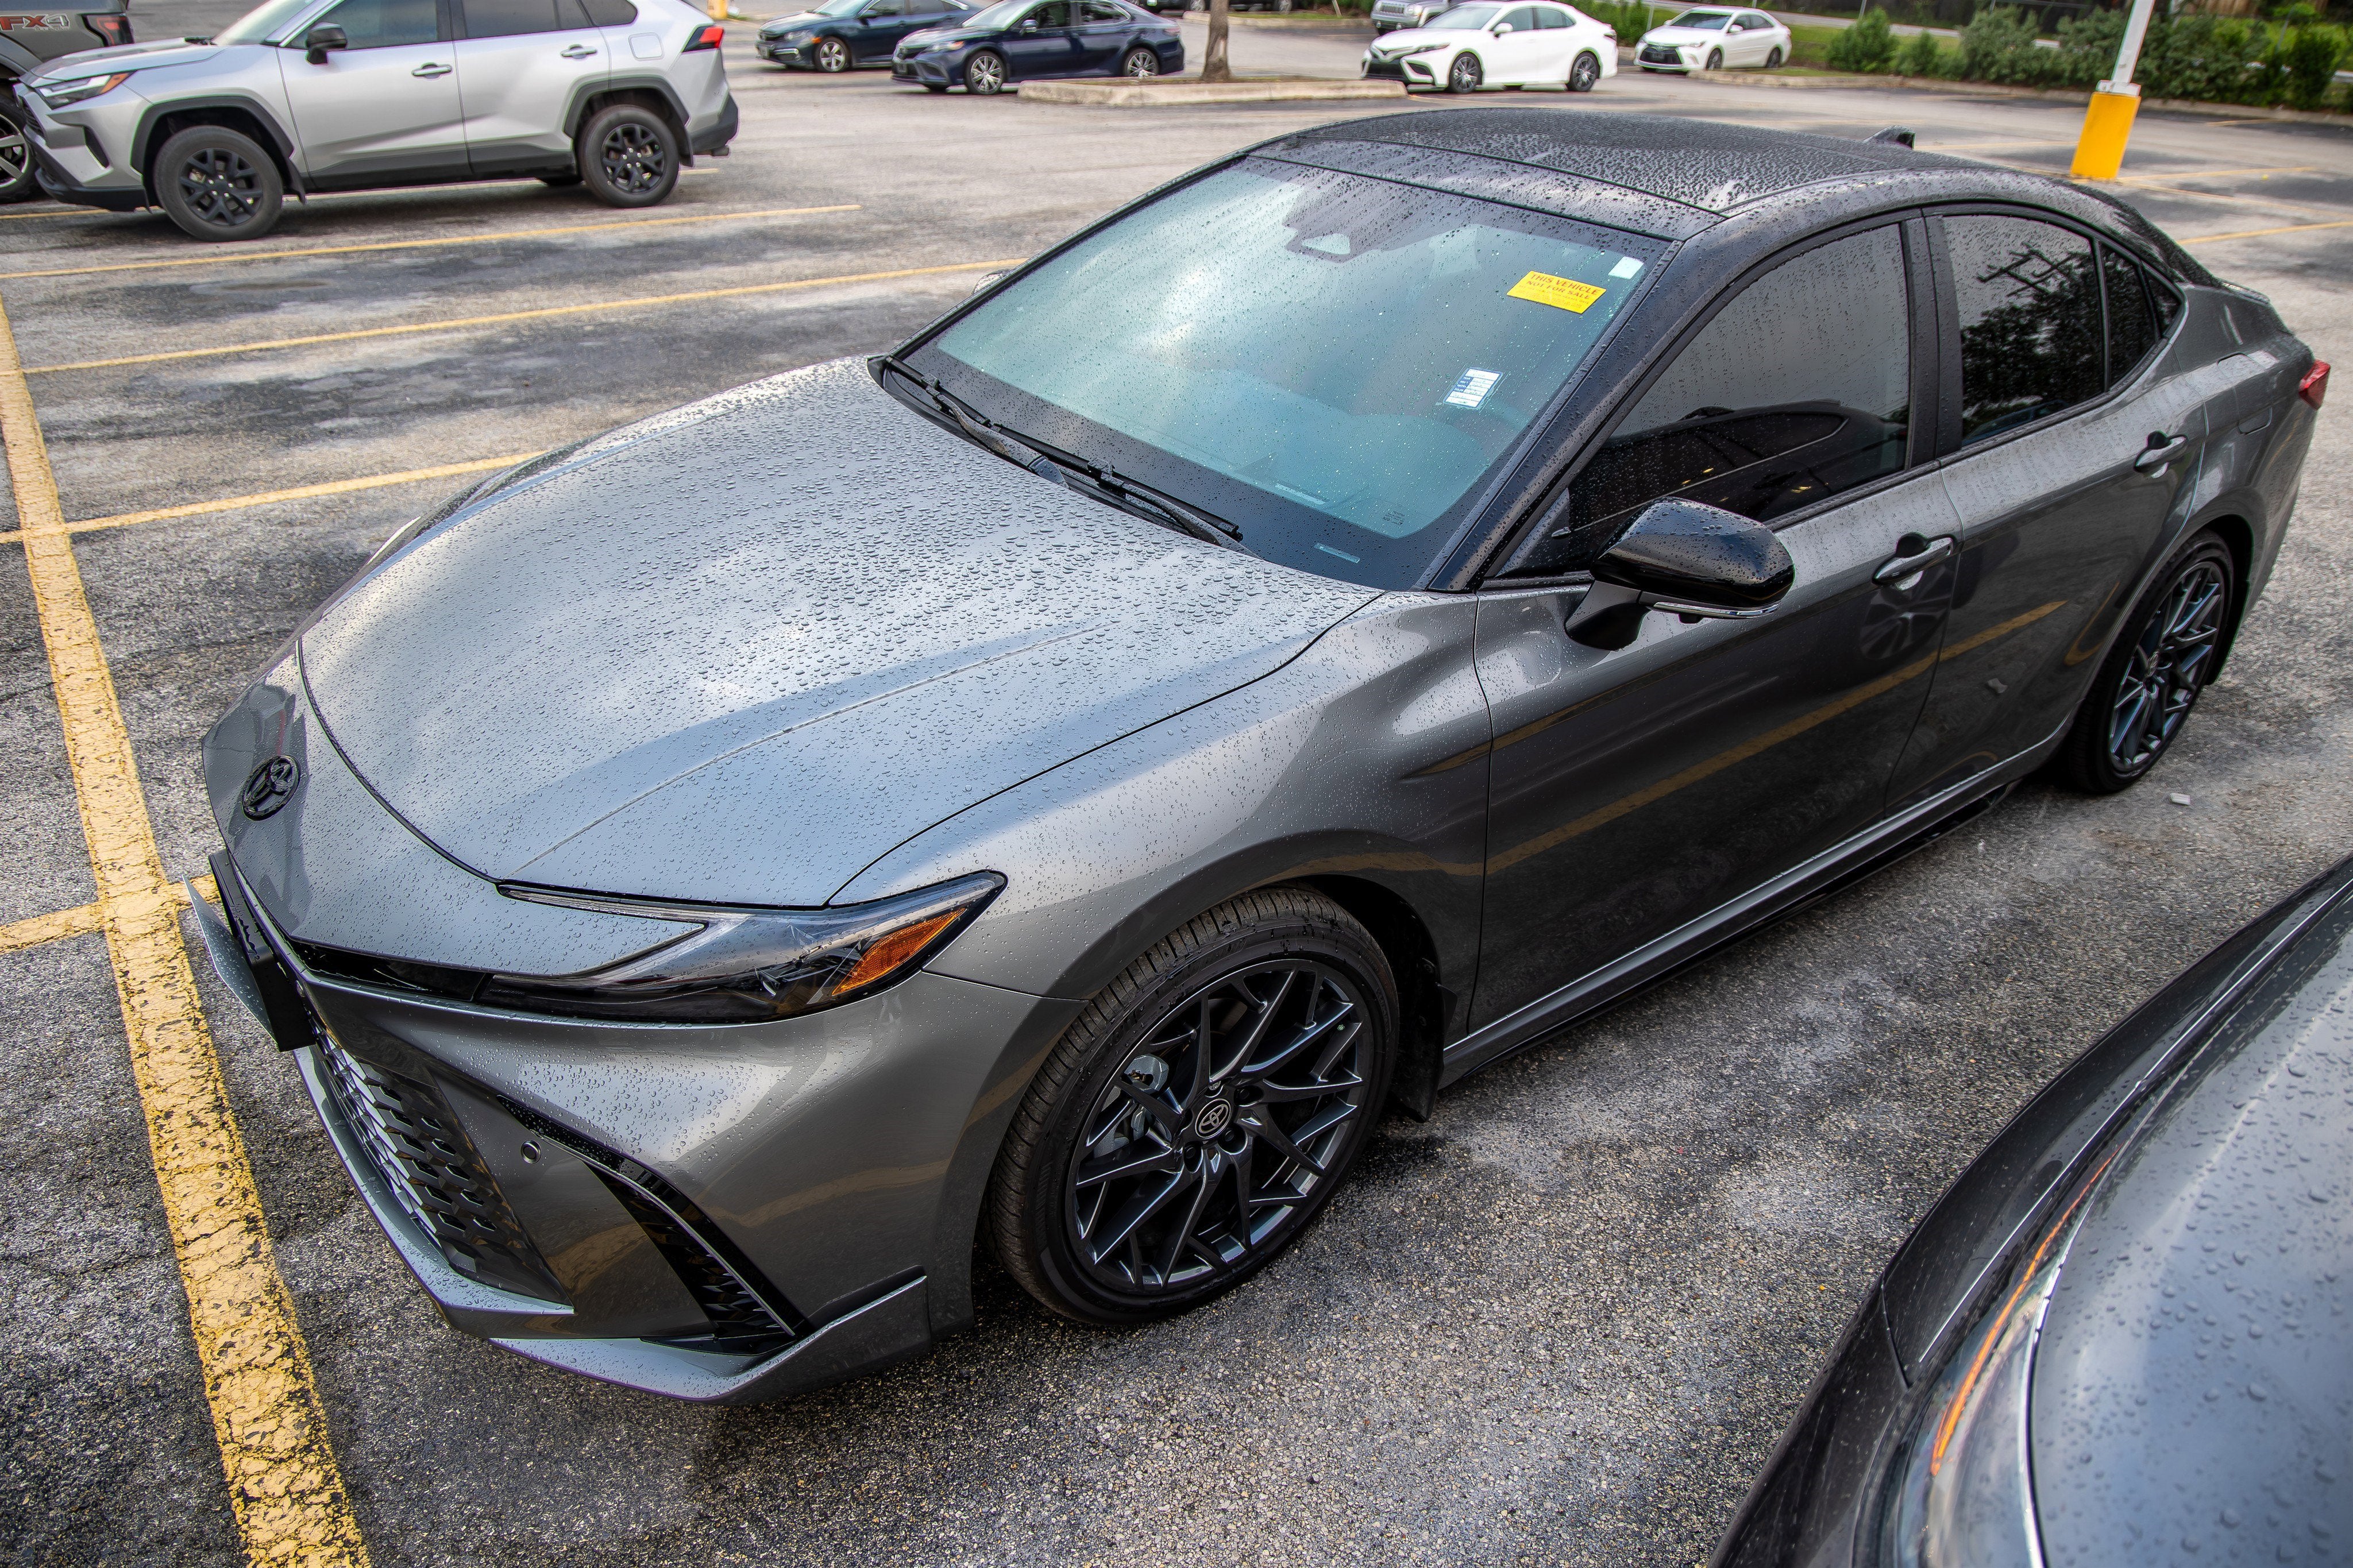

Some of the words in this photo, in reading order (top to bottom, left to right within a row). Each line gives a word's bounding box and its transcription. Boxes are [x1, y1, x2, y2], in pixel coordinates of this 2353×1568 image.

[0, 14, 70, 32] FX4
[1530, 274, 1554, 283] THIS
[1556, 279, 1600, 295] VEHICLE
[1568, 291, 1591, 299] SALE
